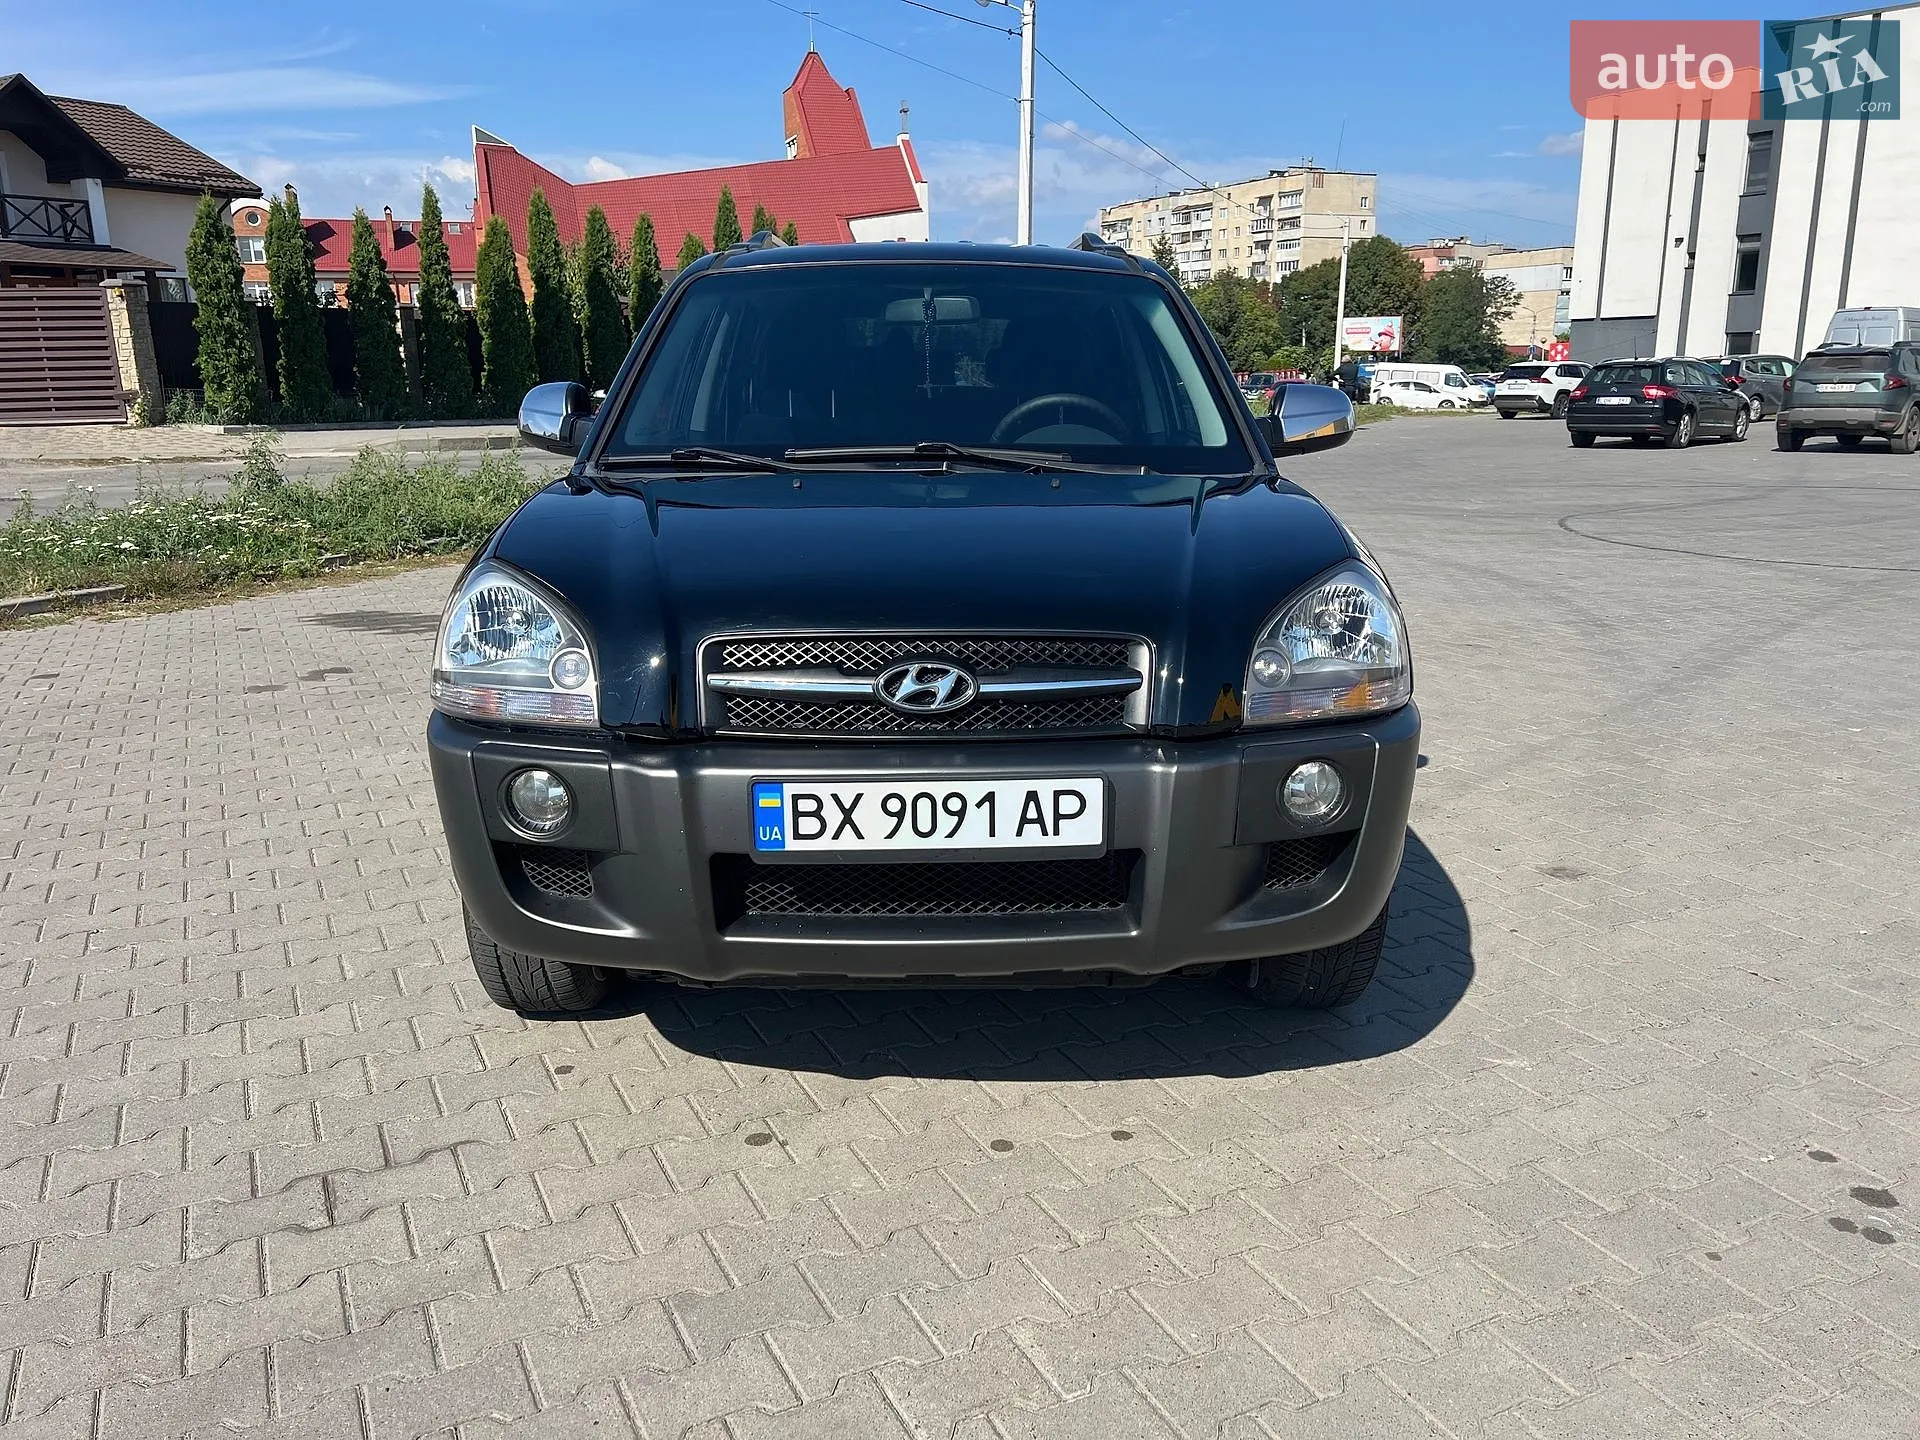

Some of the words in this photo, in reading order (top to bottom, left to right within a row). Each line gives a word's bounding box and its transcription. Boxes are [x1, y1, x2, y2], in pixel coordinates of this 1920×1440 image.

[791, 793, 865, 840] BX
[880, 791, 996, 839] 9091
[1015, 790, 1087, 837] AP
[759, 826, 782, 841] UA
